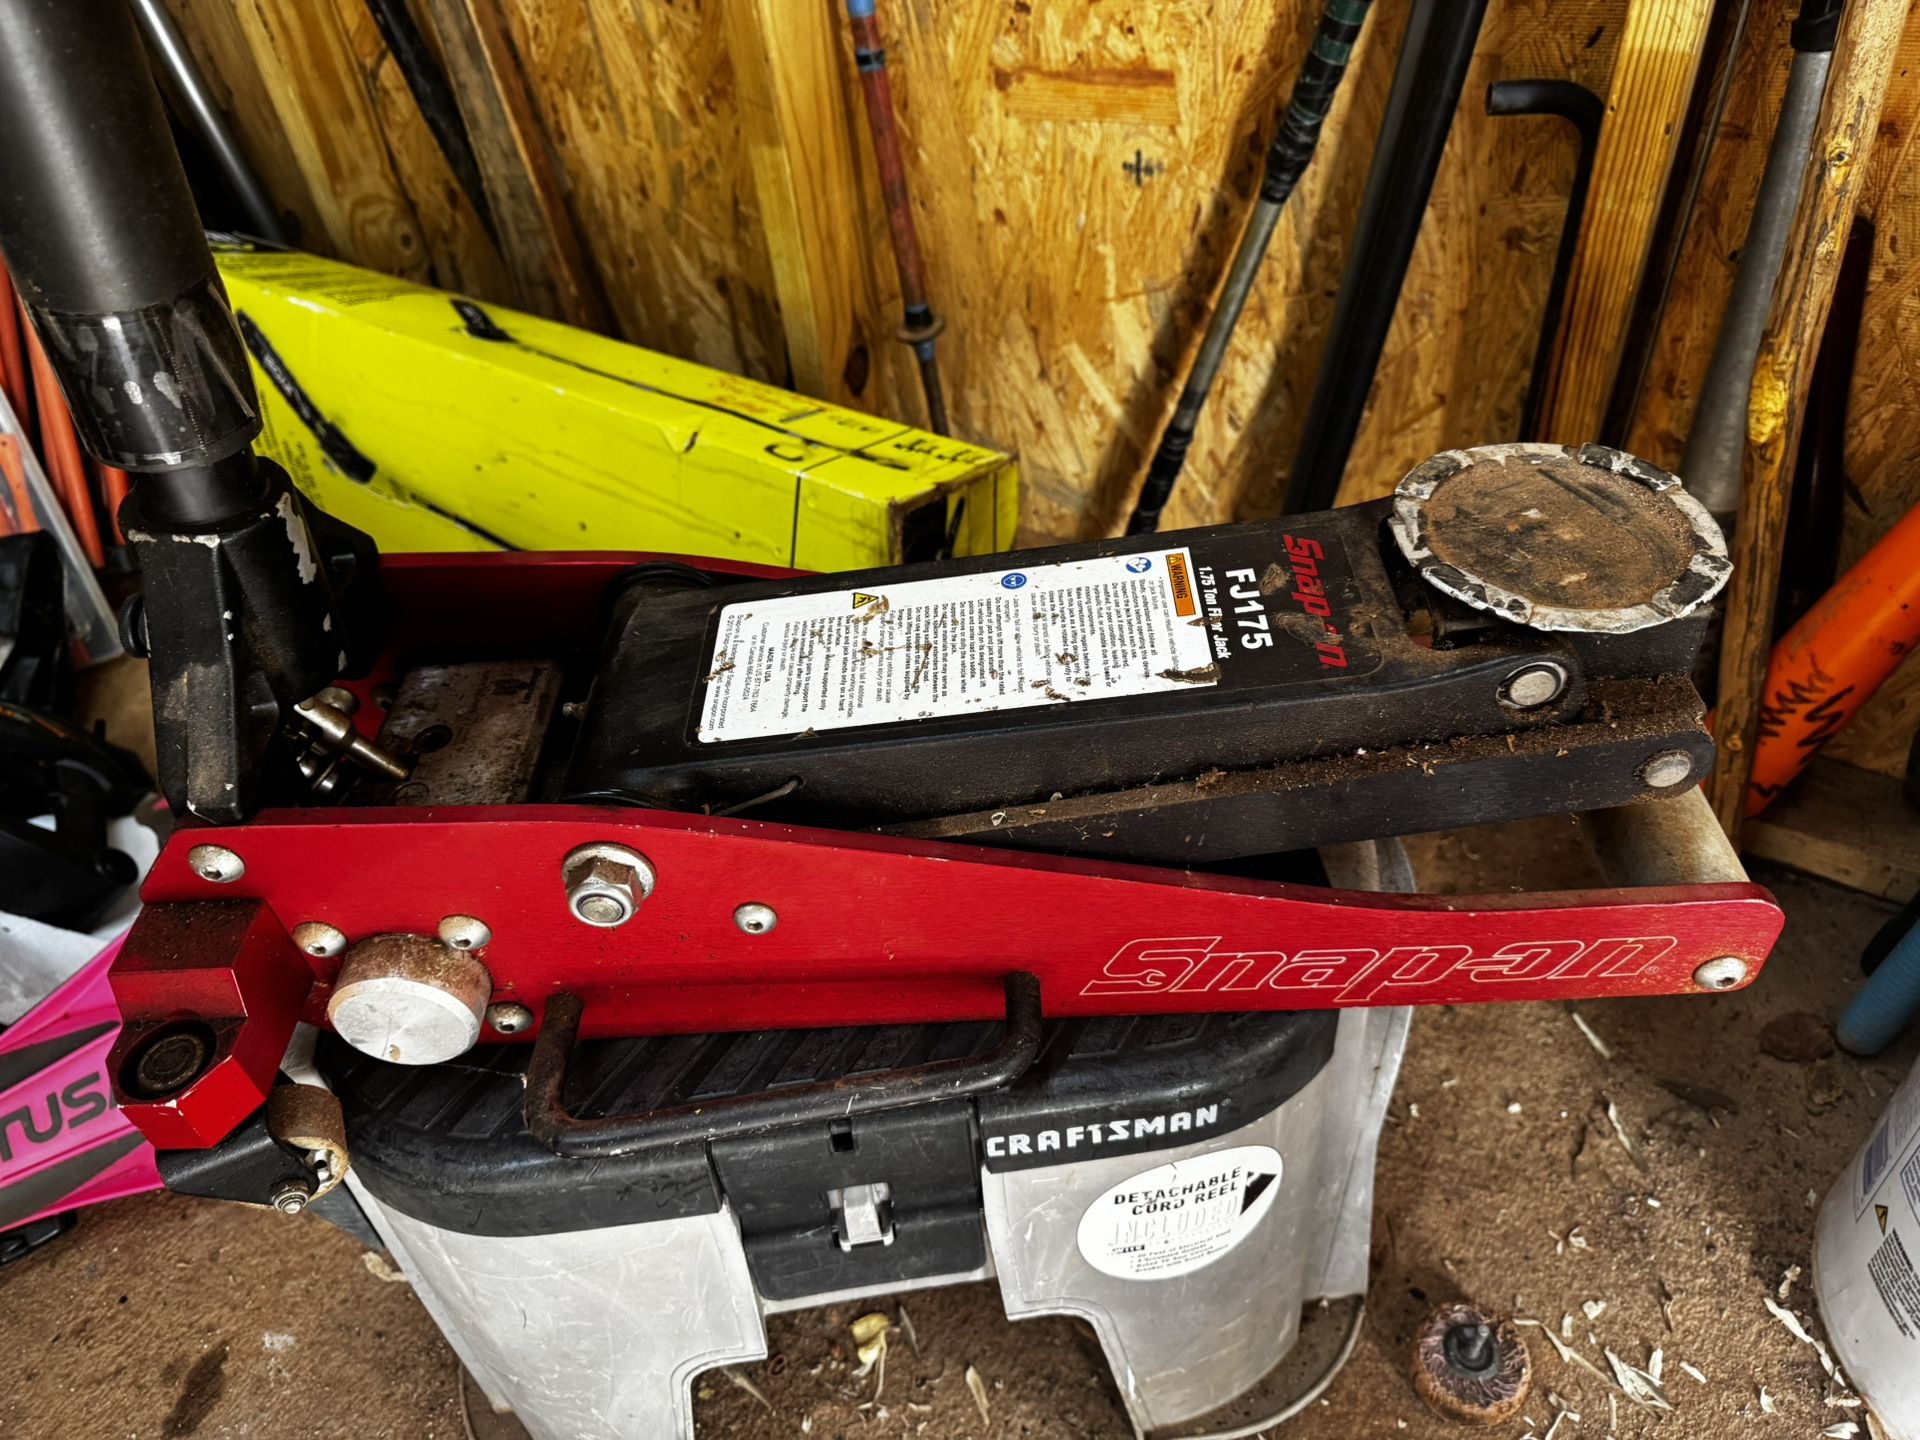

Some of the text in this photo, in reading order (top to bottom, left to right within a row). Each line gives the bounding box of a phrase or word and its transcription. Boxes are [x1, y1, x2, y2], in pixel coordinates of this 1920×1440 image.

[1170, 563, 1187, 599] WARNING
[1199, 566, 1232, 659] 1.75 Ton Flor Jack
[1226, 568, 1274, 649] FJ175
[0, 1072, 117, 1161] TUS
[986, 1104, 1218, 1158] CRAFTSMAN
[1114, 1167, 1242, 1206] DETACHABLE
[1195, 1183, 1238, 1205] REEL
